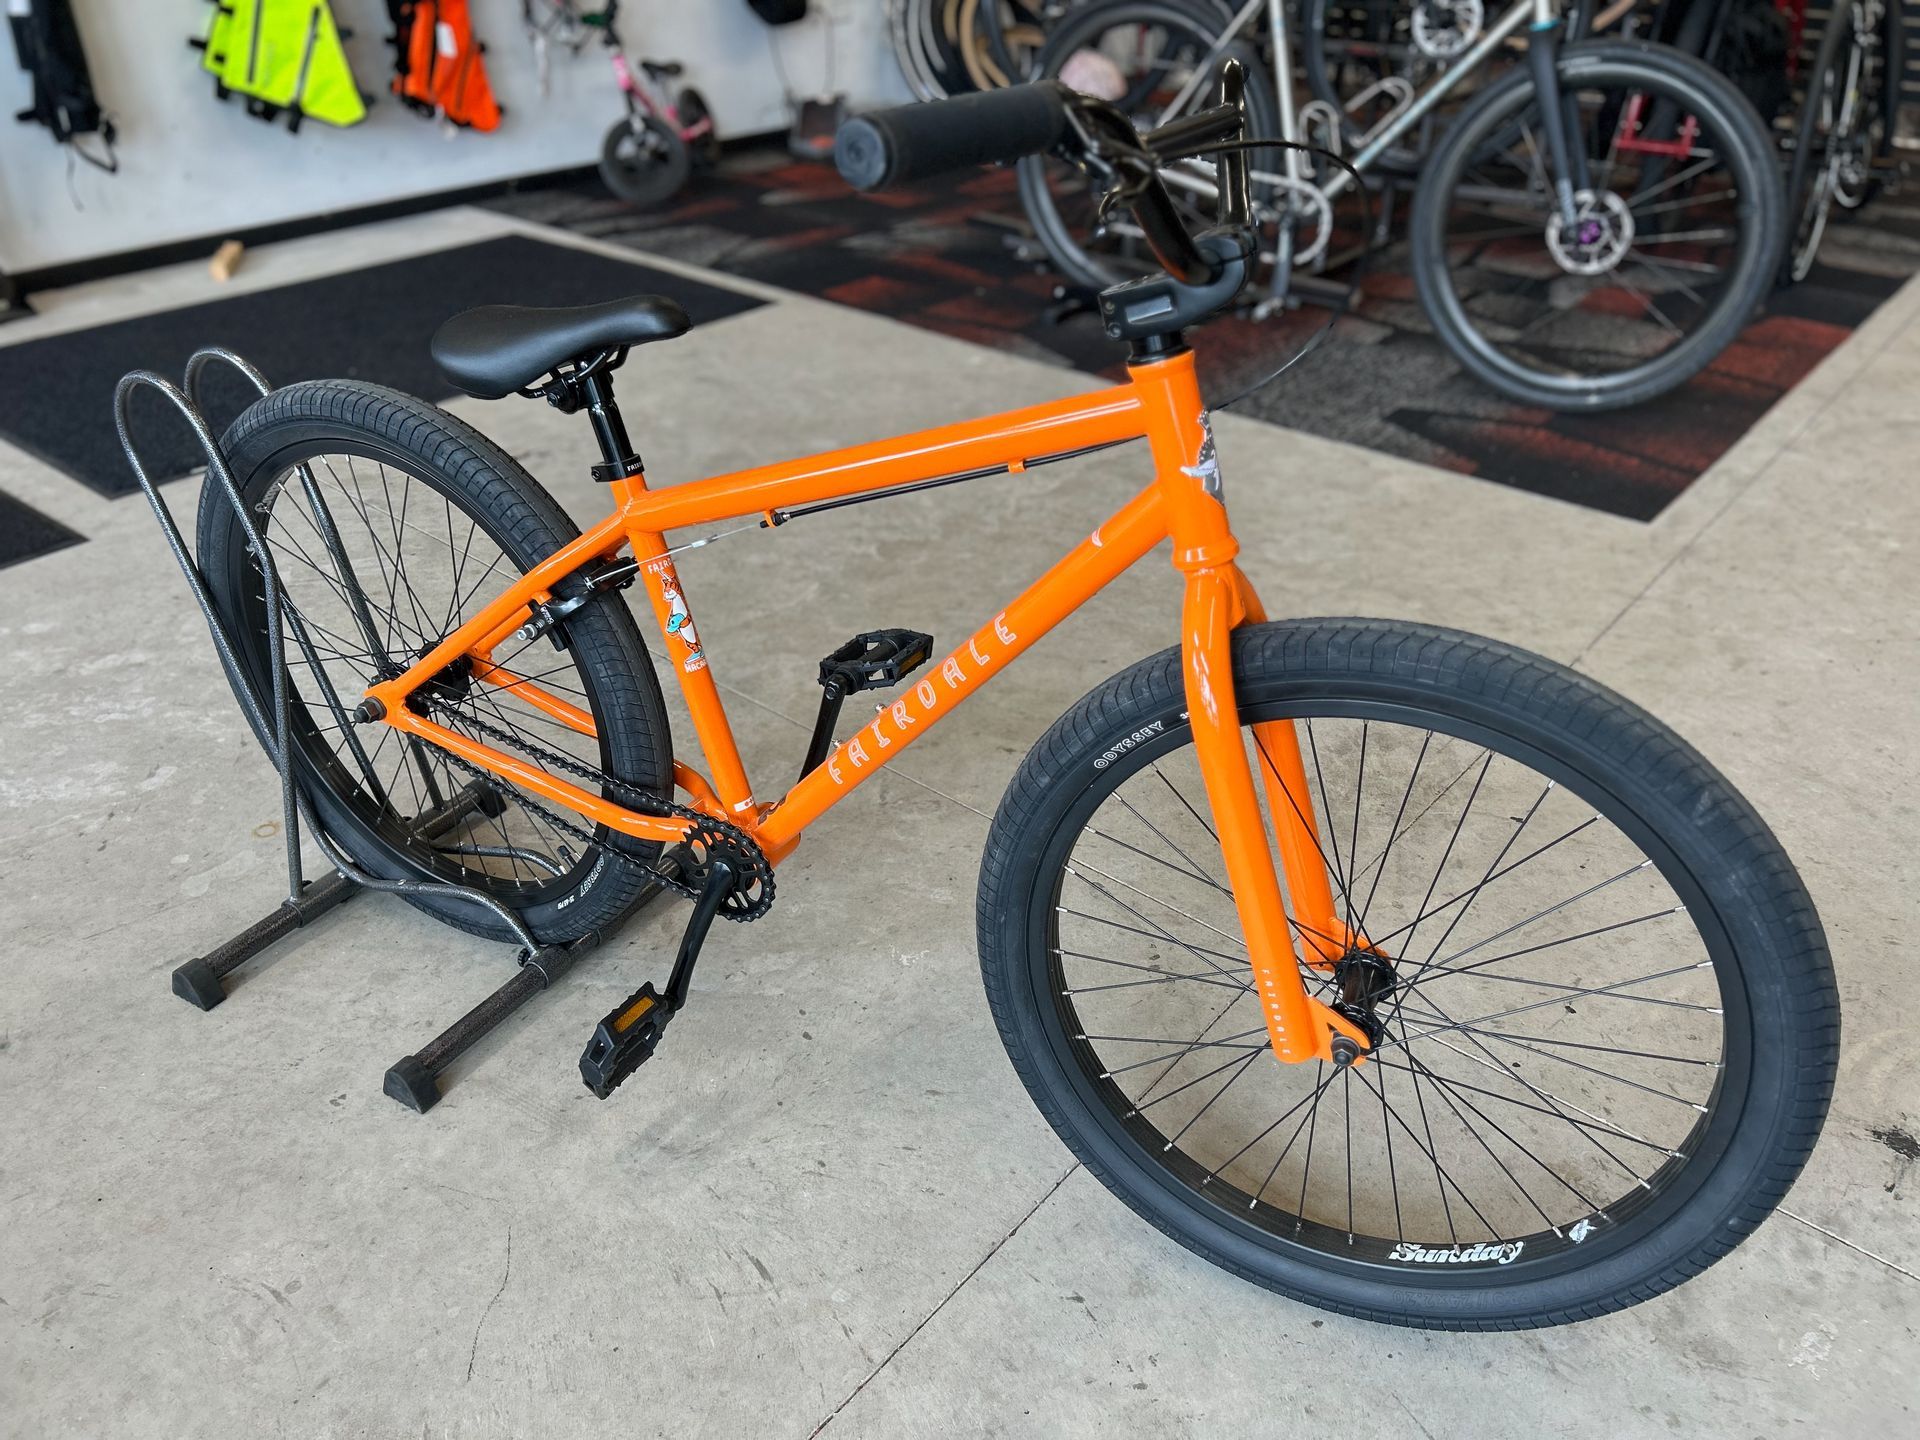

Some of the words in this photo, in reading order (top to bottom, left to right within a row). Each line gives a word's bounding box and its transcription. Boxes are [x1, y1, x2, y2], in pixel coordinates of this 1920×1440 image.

[828, 612, 1016, 785] FAIRDALE
[1094, 720, 1164, 769] ODYSSEY
[581, 855, 605, 898] ODYSSEY
[1262, 969, 1291, 1055] FAIRDALE
[1389, 1241, 1525, 1264] Sunday
